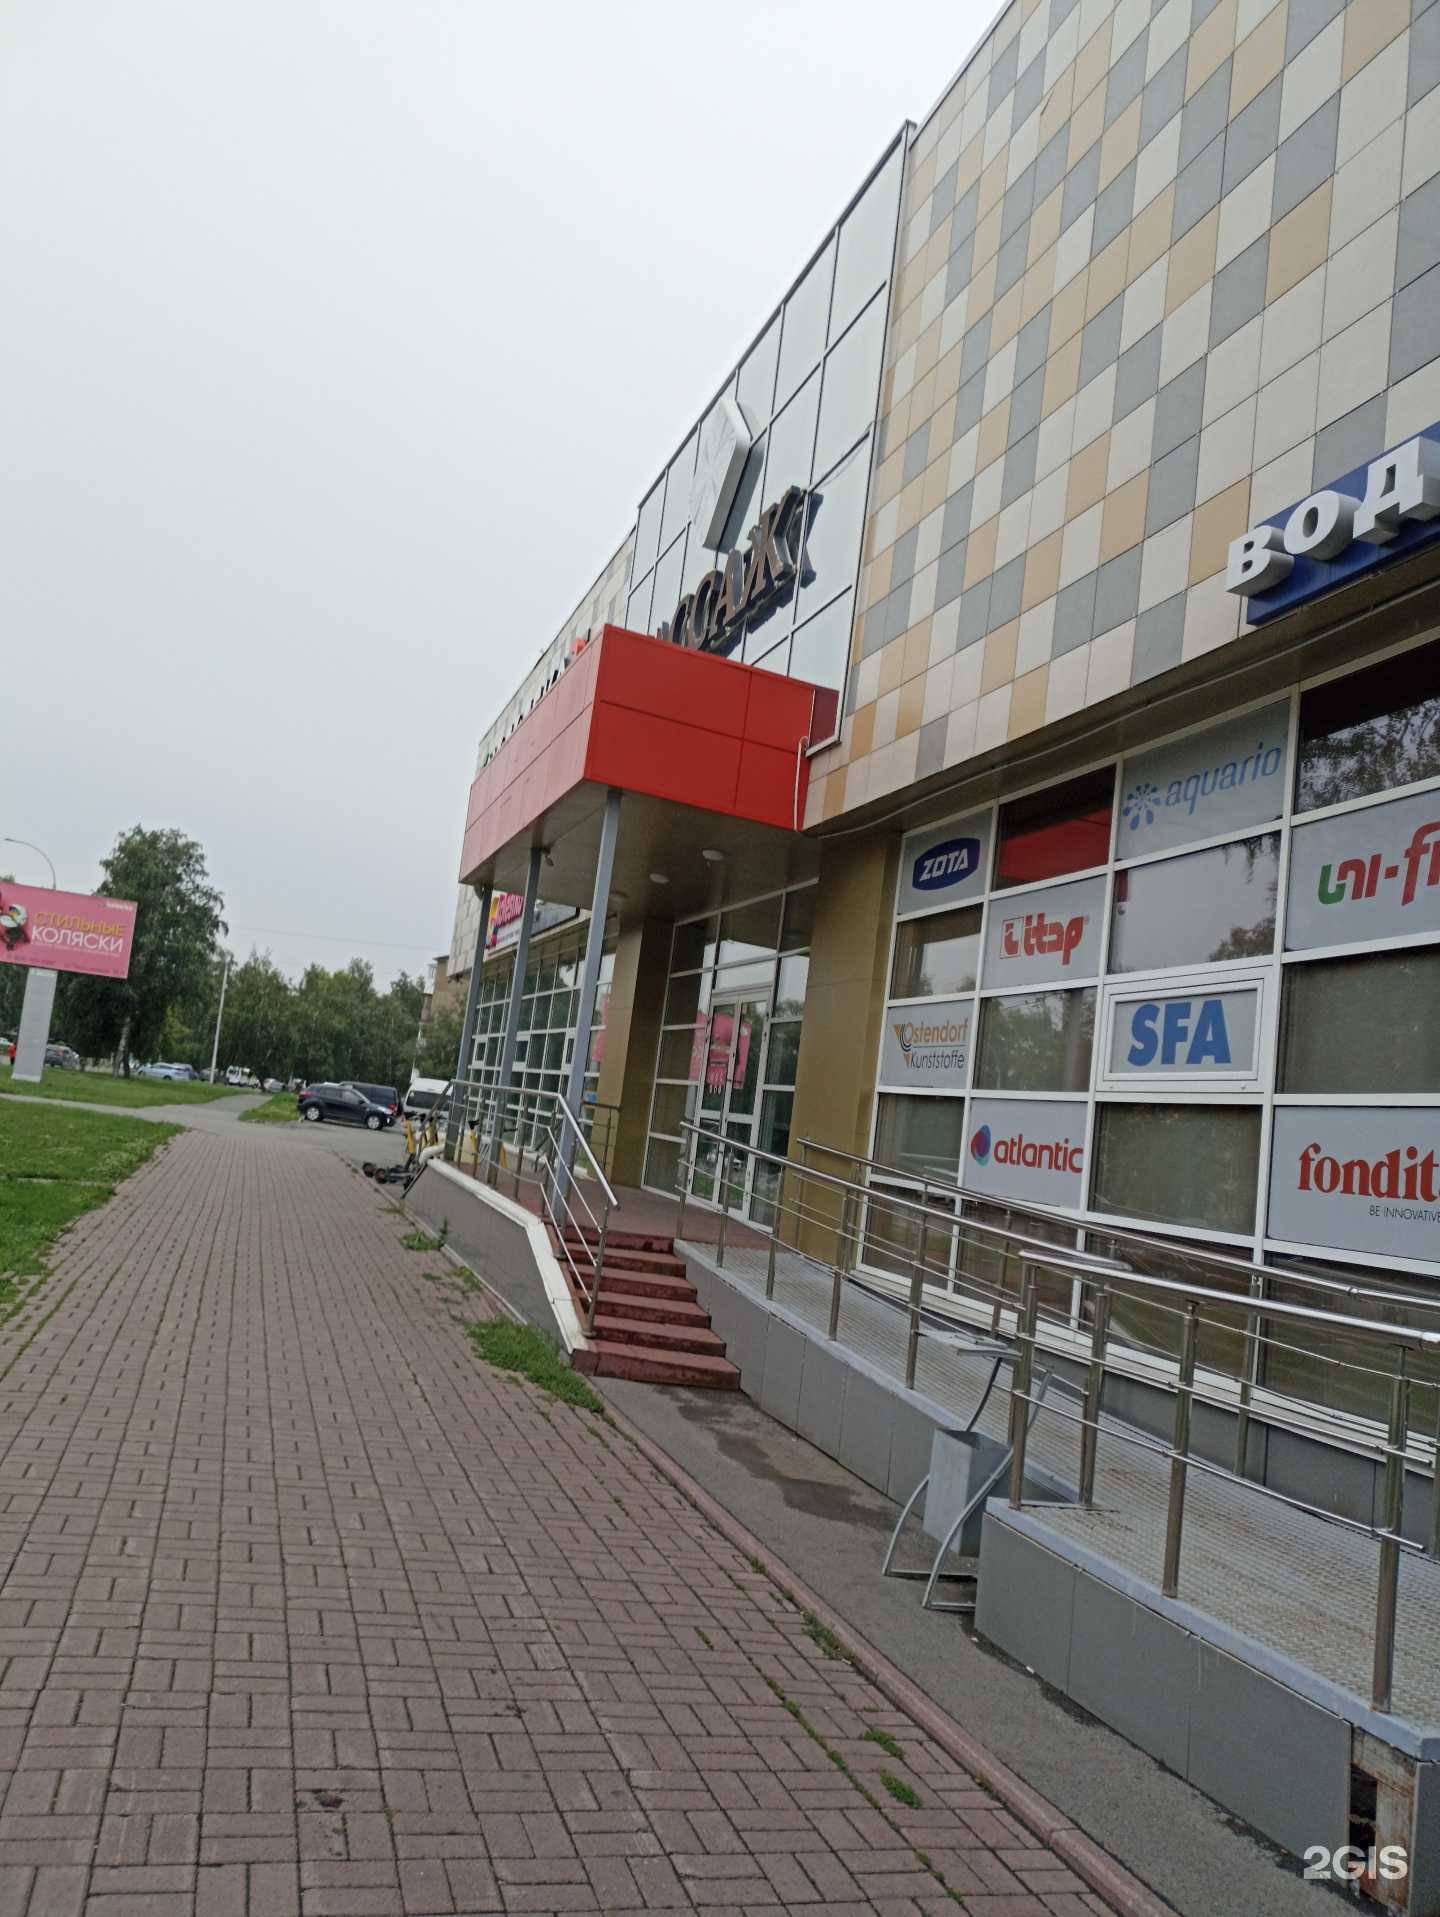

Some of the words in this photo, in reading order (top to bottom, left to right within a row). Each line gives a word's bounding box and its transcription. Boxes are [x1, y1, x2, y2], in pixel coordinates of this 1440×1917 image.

[1165, 742, 1282, 815] aquario
[919, 848, 969, 882] ZOTA
[31, 926, 123, 953] КОЛЯСКИ
[35, 912, 127, 937] СТИЛЬНЫЕ
[1023, 912, 1085, 966] itap
[904, 1017, 969, 1044] Ostendorf
[1127, 999, 1231, 1067] SFA
[911, 1050, 965, 1069] Kunststoffe
[993, 1133, 1084, 1173] atlantic
[1297, 1142, 1440, 1202] fondit
[1369, 1204, 1381, 1217] BE
